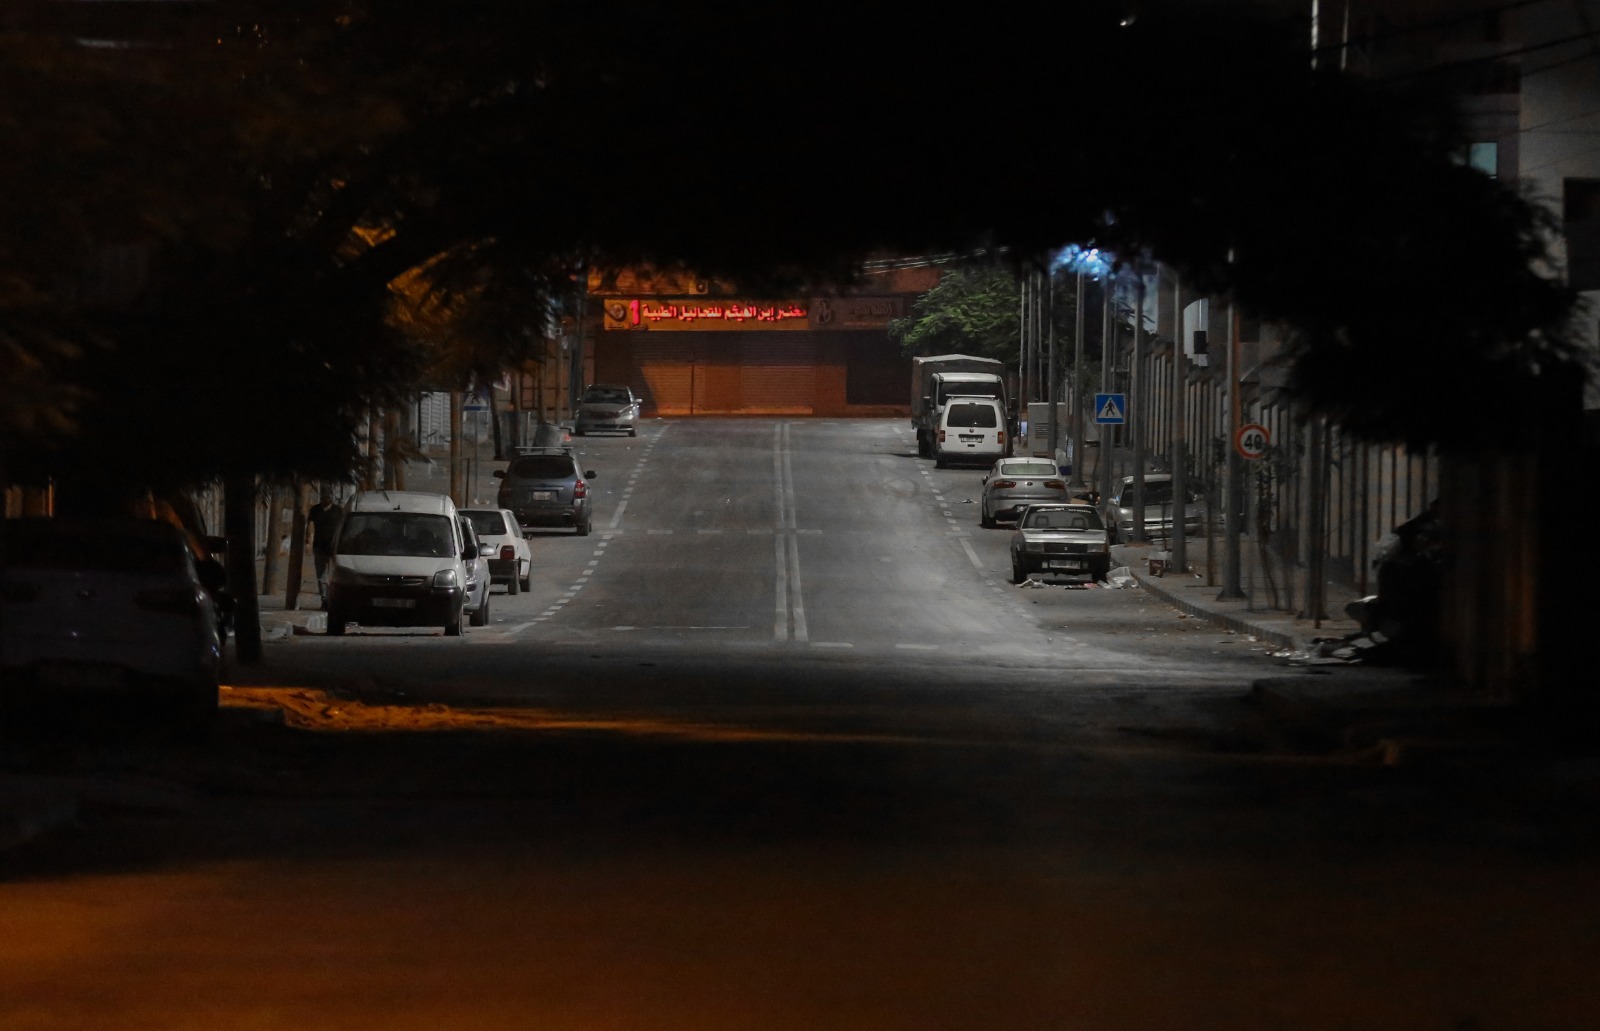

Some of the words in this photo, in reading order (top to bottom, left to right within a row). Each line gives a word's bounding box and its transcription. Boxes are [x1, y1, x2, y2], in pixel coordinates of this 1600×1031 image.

[642, 304, 677, 321] الطبية
[678, 305, 722, 321] للتحاليل
[724, 304, 757, 321] الهيثم
[1244, 433, 1263, 450] 40
